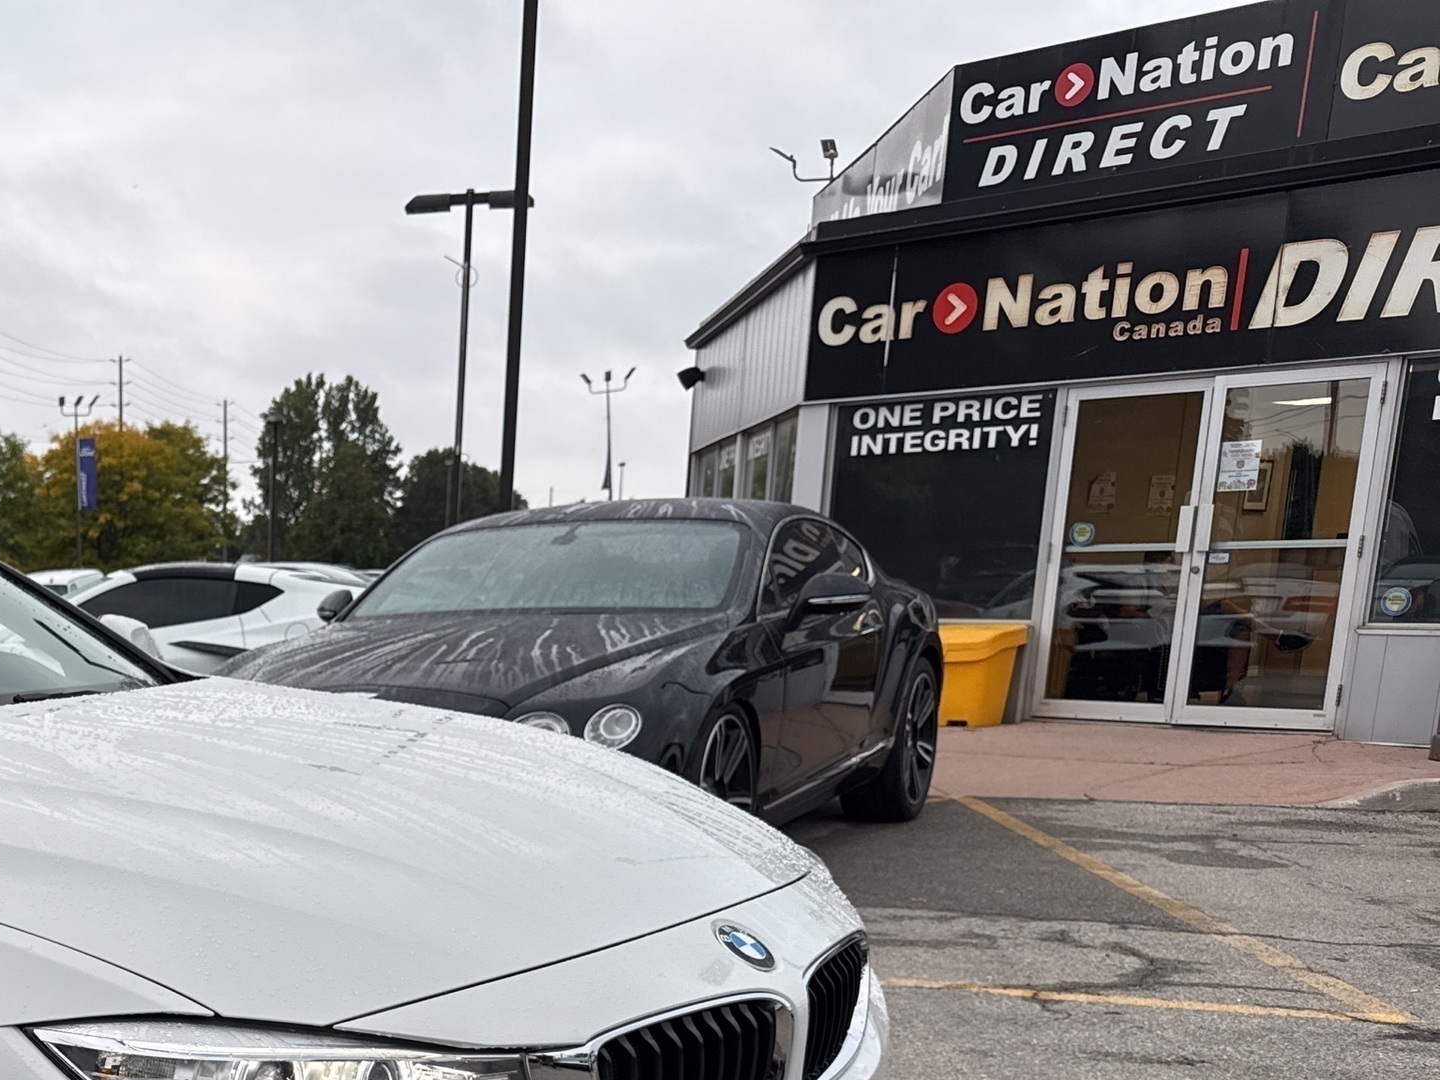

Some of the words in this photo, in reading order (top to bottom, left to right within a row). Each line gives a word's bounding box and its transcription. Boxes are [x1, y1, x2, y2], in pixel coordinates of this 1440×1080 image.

[978, 103, 1248, 188] DIRECT
[1112, 314, 1222, 342] Canada
[852, 403, 925, 430] ONE
[931, 394, 1044, 425] PRICE
[849, 423, 1040, 457] INTEGRITY!
